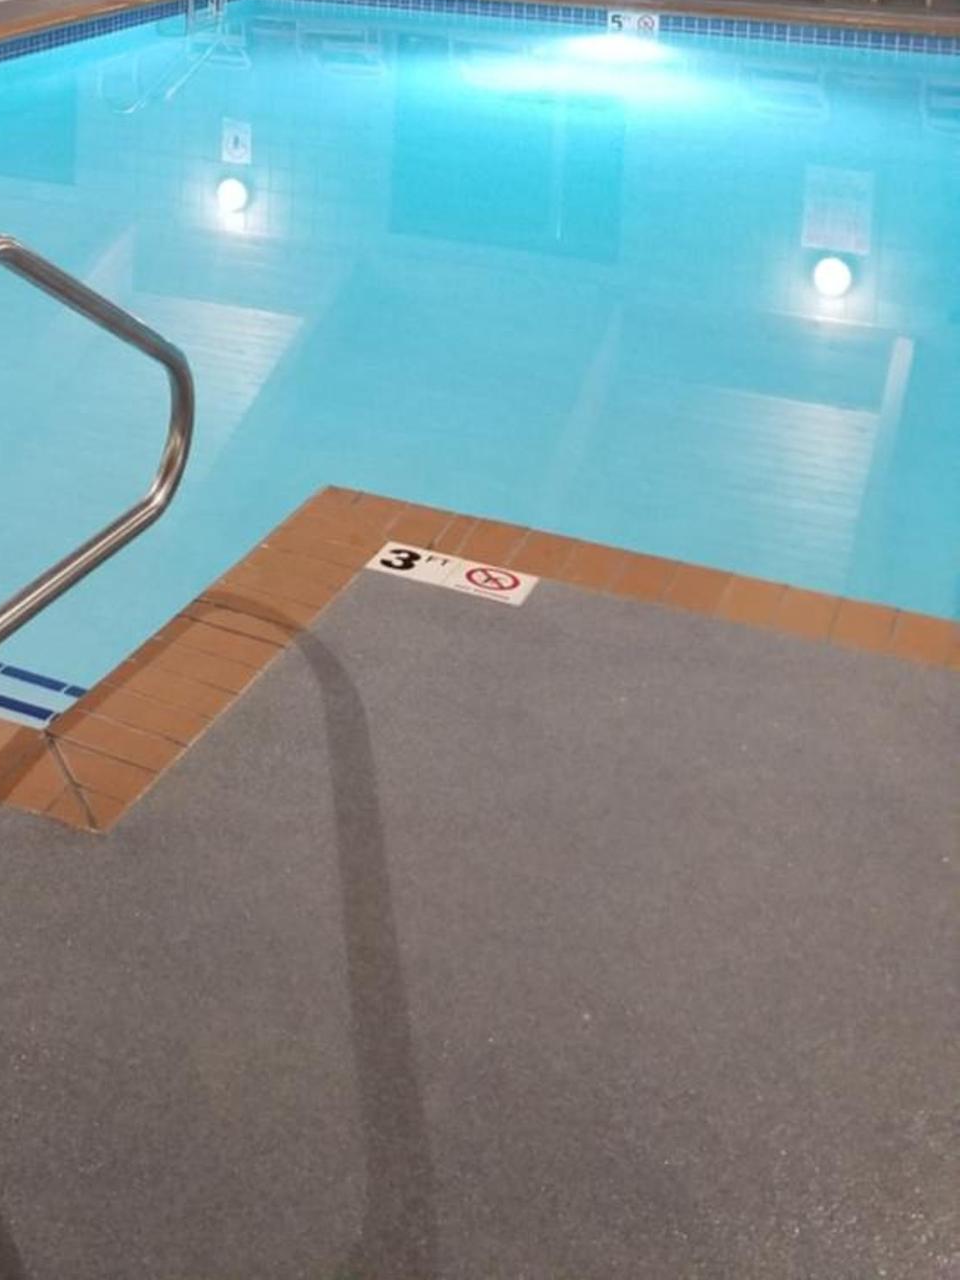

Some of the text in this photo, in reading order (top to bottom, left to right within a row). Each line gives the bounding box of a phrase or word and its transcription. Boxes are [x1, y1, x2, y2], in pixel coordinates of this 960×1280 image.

[611, 14, 623, 31] 5
[380, 549, 450, 571] 3 FT
